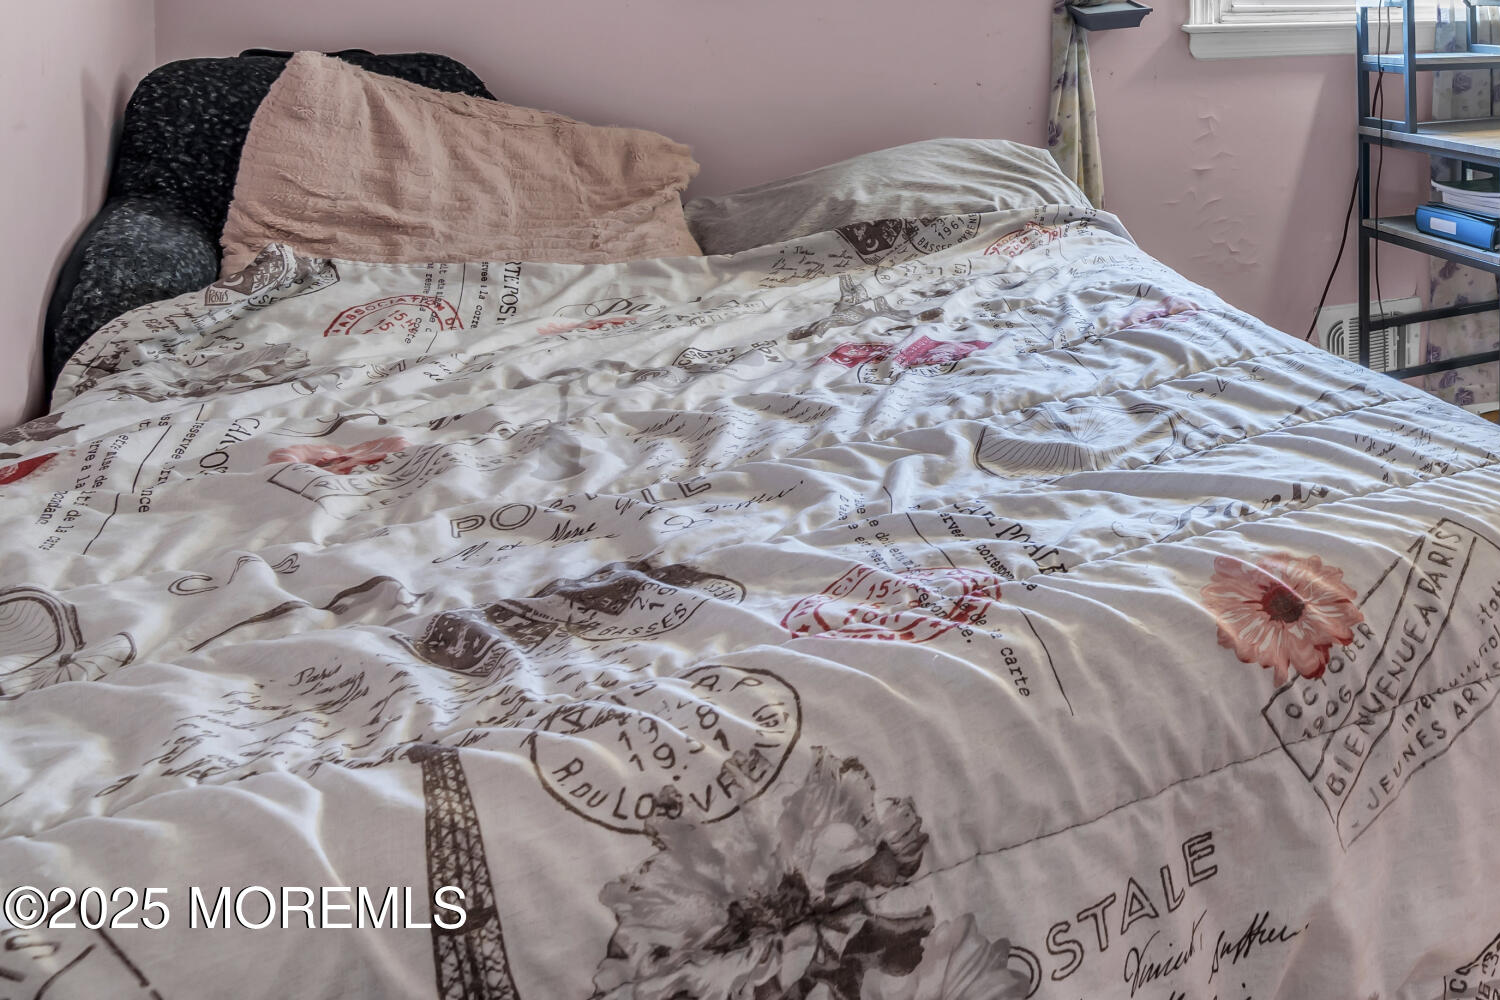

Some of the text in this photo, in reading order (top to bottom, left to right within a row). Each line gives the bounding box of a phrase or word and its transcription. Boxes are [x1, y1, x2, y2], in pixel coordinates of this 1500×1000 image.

[1417, 529, 1462, 600] PARIS
[1000, 647, 1030, 697] carte
[1366, 719, 1447, 811] JEUNES
